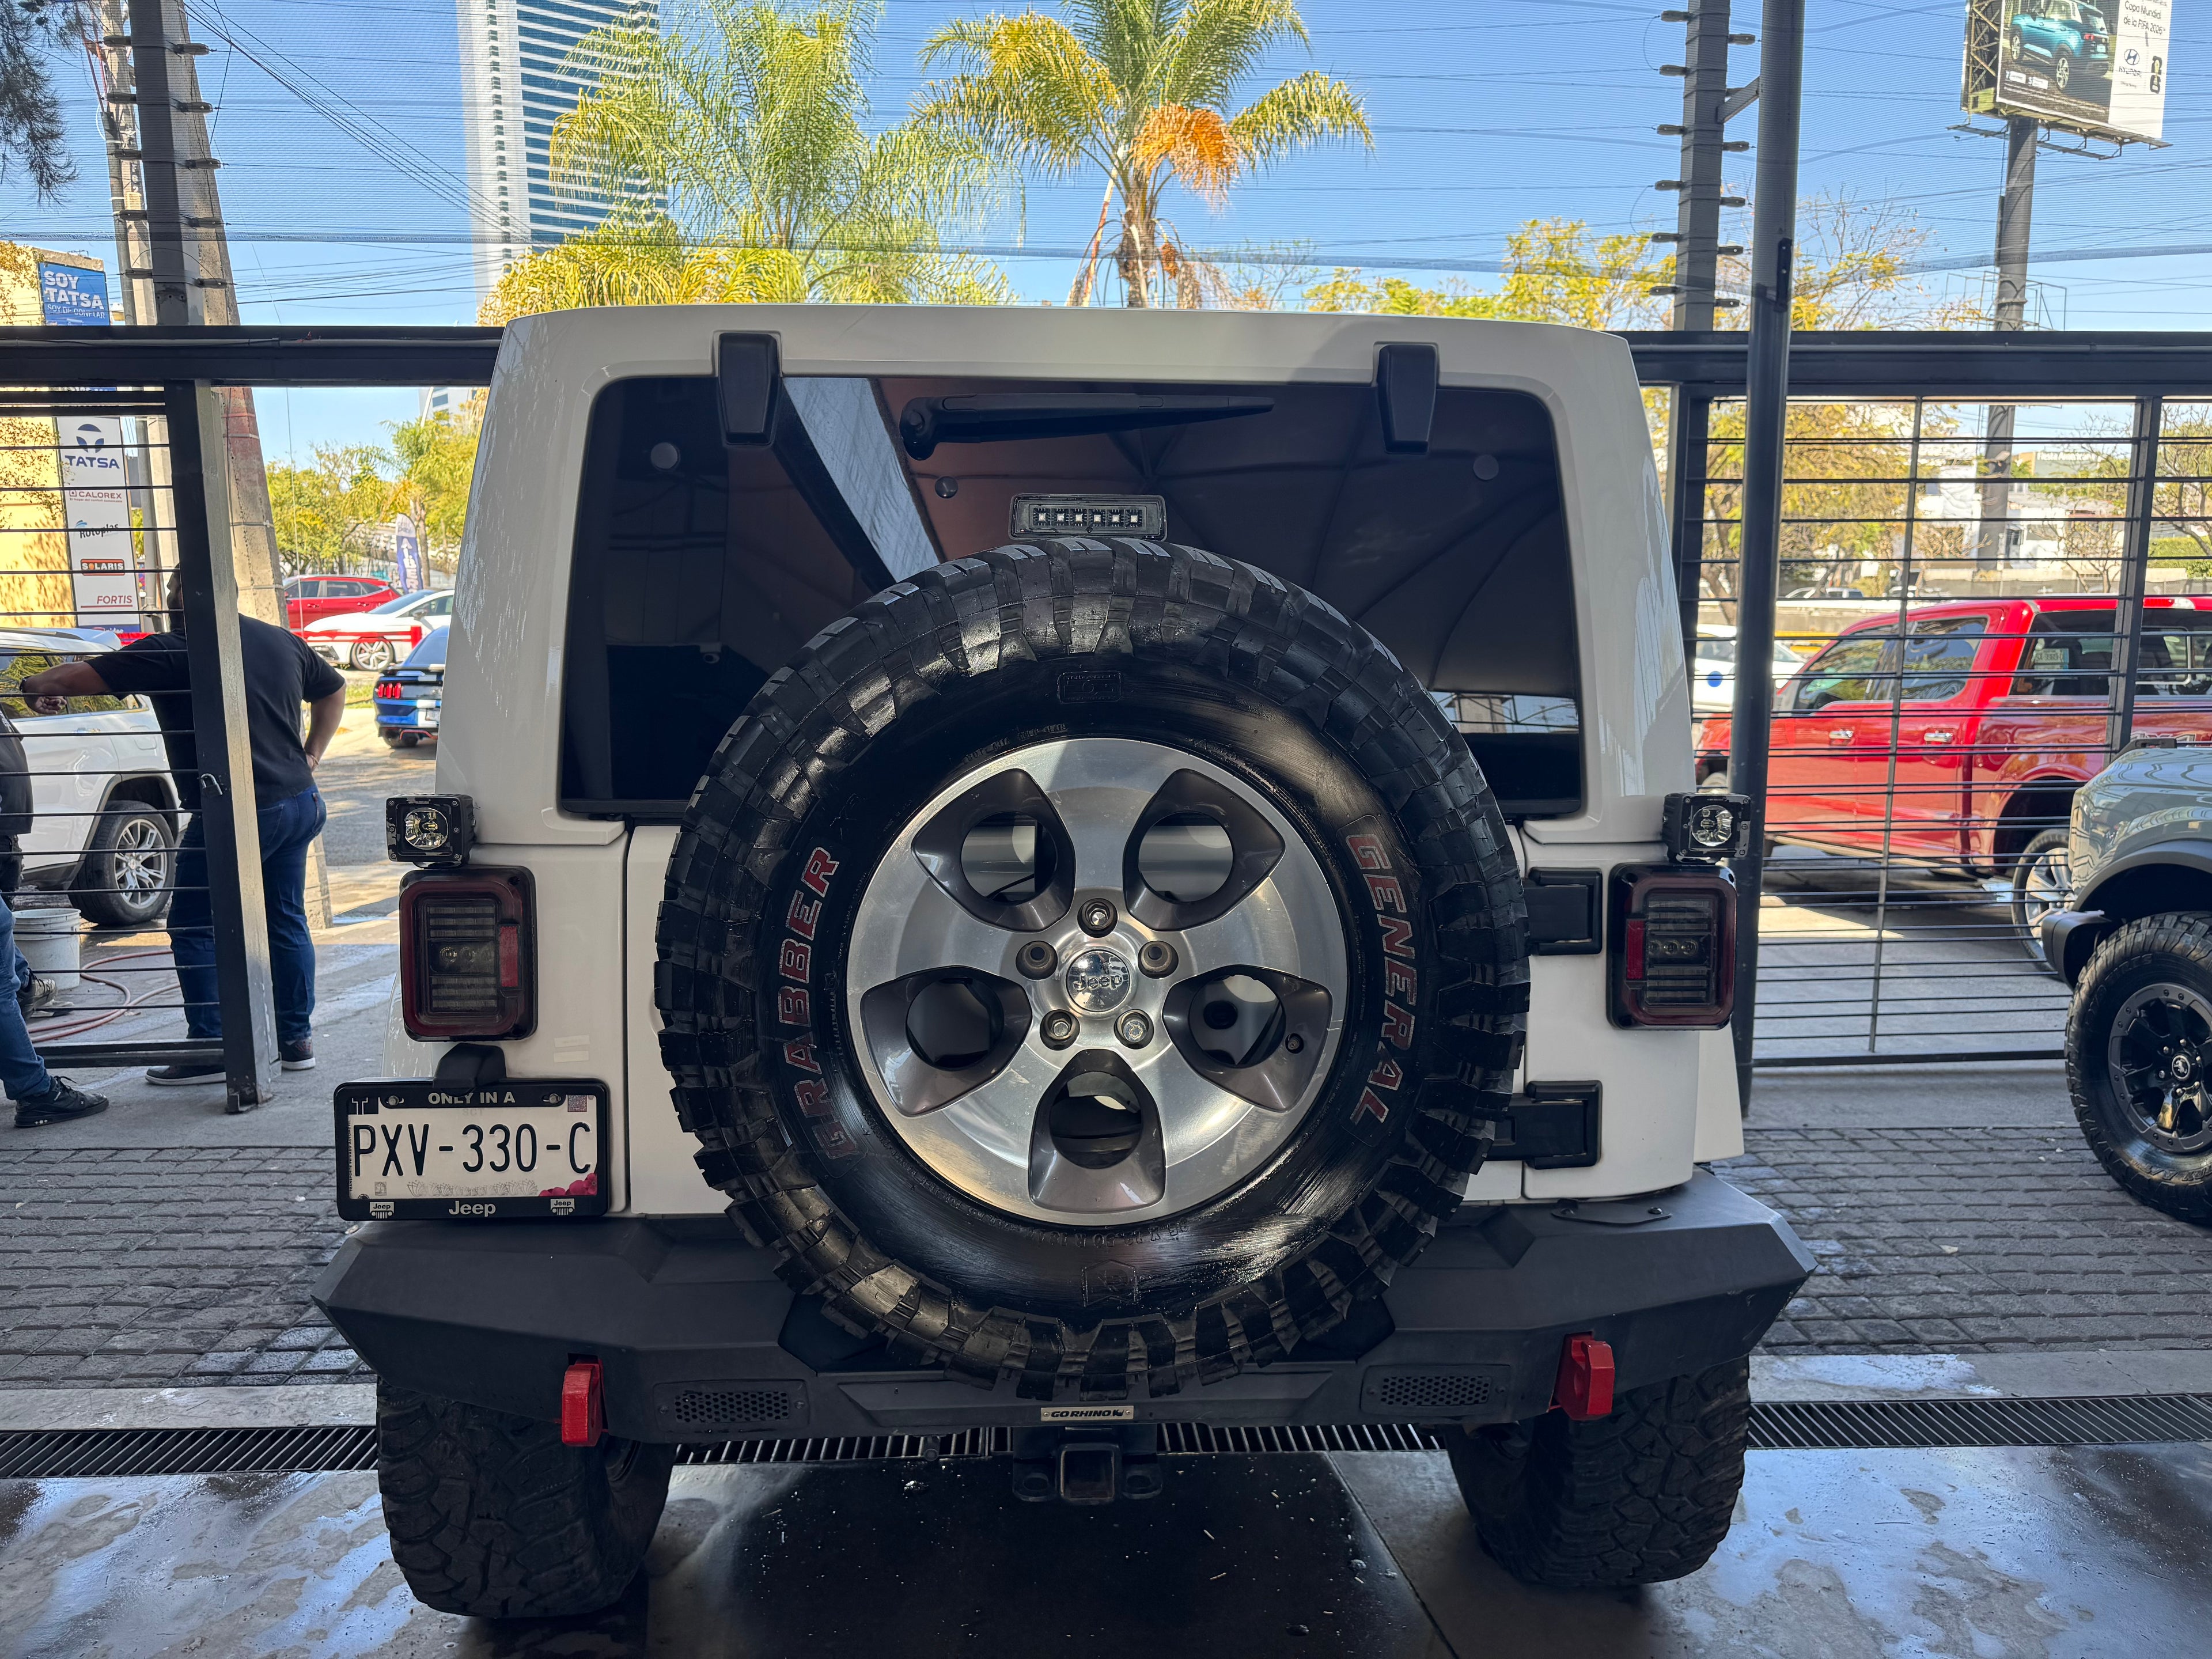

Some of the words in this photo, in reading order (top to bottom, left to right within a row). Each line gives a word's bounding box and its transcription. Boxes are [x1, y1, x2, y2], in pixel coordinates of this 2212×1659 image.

[2125, 1, 2140, 12] Copa
[44, 271, 79, 290] SOY
[45, 287, 104, 310] TATSA
[47, 304, 61, 312] SOY
[65, 455, 120, 469] TATSA
[79, 491, 122, 499] CALOREX
[79, 523, 119, 539] Rotoplas
[97, 595, 132, 604] FORTIS
[1073, 972, 1124, 992] Jeep
[1345, 833, 1417, 1126] GENERAL
[778, 846, 858, 1160] GRABBER
[428, 1092, 474, 1104] ONLY
[480, 1092, 498, 1104] IN
[503, 1092, 516, 1104] A
[353, 1122, 591, 1177] PXV-330-C
[373, 1203, 391, 1211] Jeep
[448, 1200, 497, 1217] Jeep
[554, 1199, 572, 1207] Jeep
